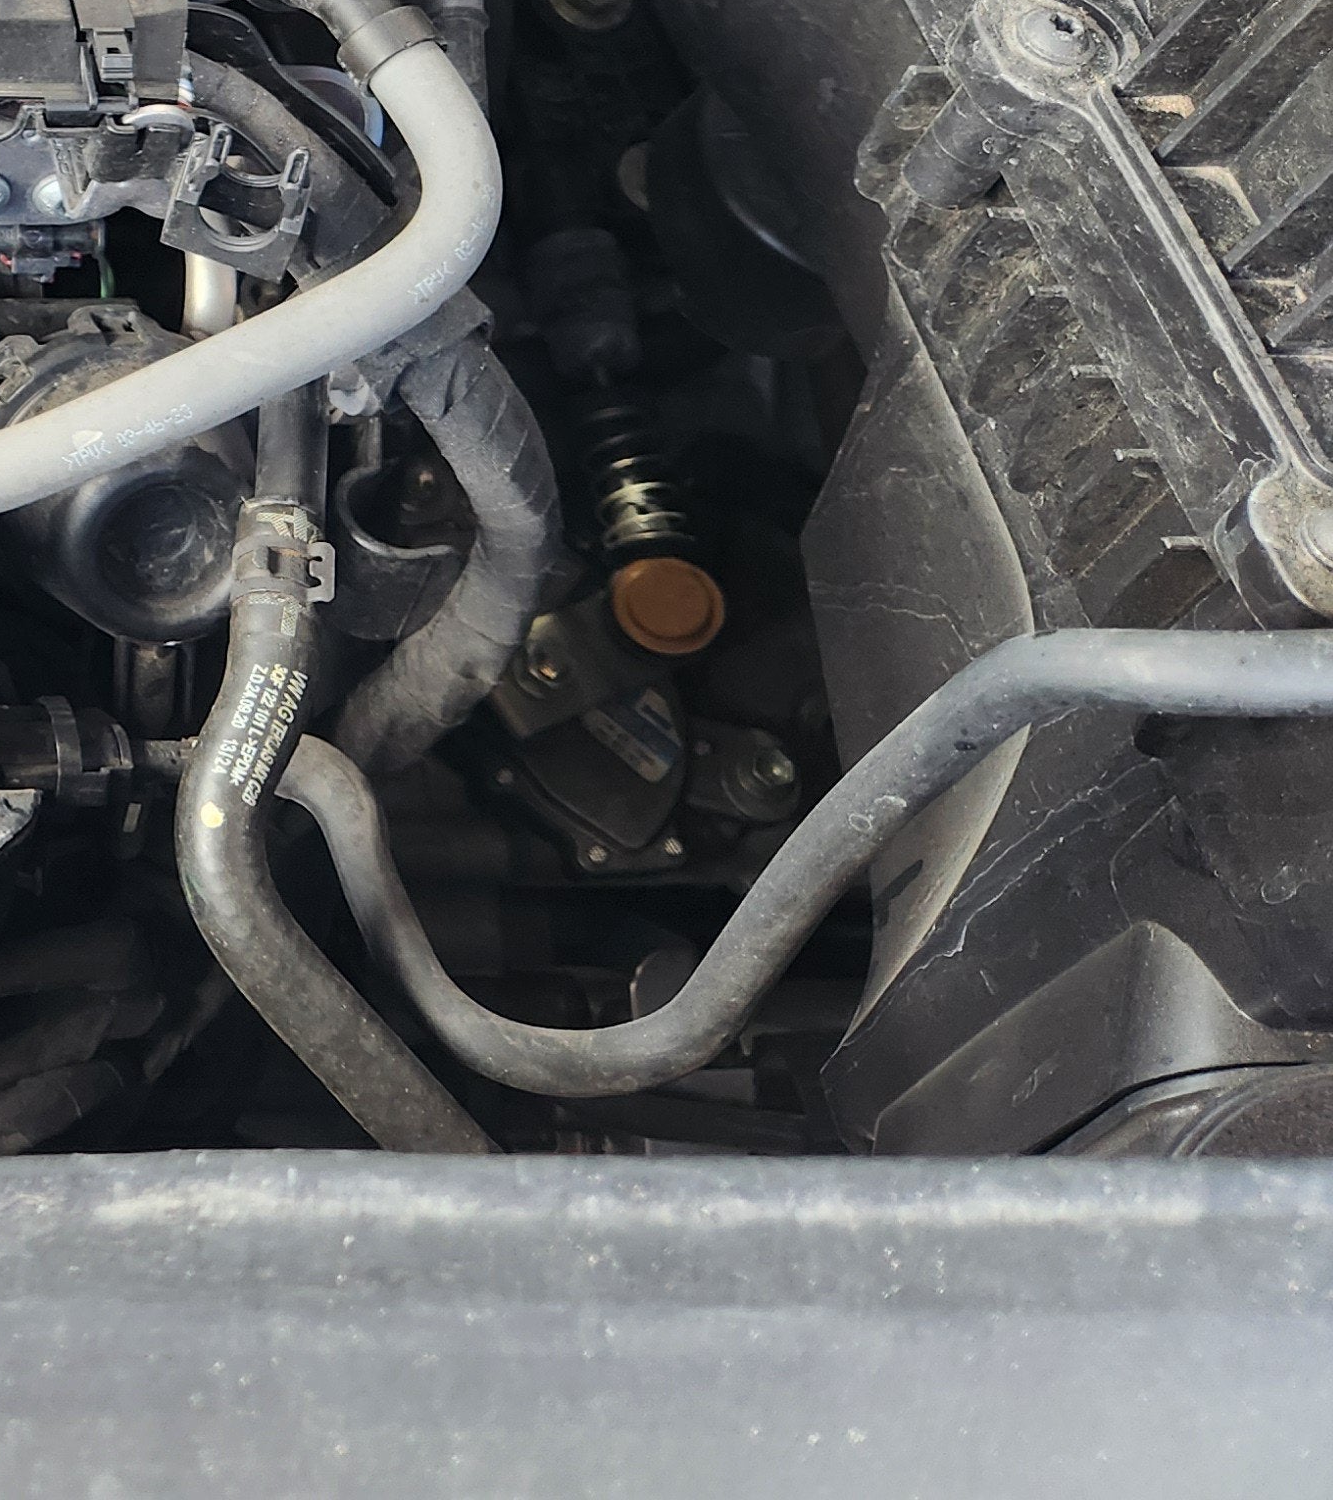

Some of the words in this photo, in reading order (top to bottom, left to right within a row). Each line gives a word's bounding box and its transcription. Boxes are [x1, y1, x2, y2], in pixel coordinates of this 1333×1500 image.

[261, 687, 279, 709] 122
[286, 670, 308, 701] VW
[252, 707, 271, 729] 101
[277, 693, 298, 724] AG
[211, 738, 239, 775] 13/24
[261, 719, 288, 765] TEKLAS
[229, 737, 259, 787] >EPDM<
[251, 759, 270, 785] MX
